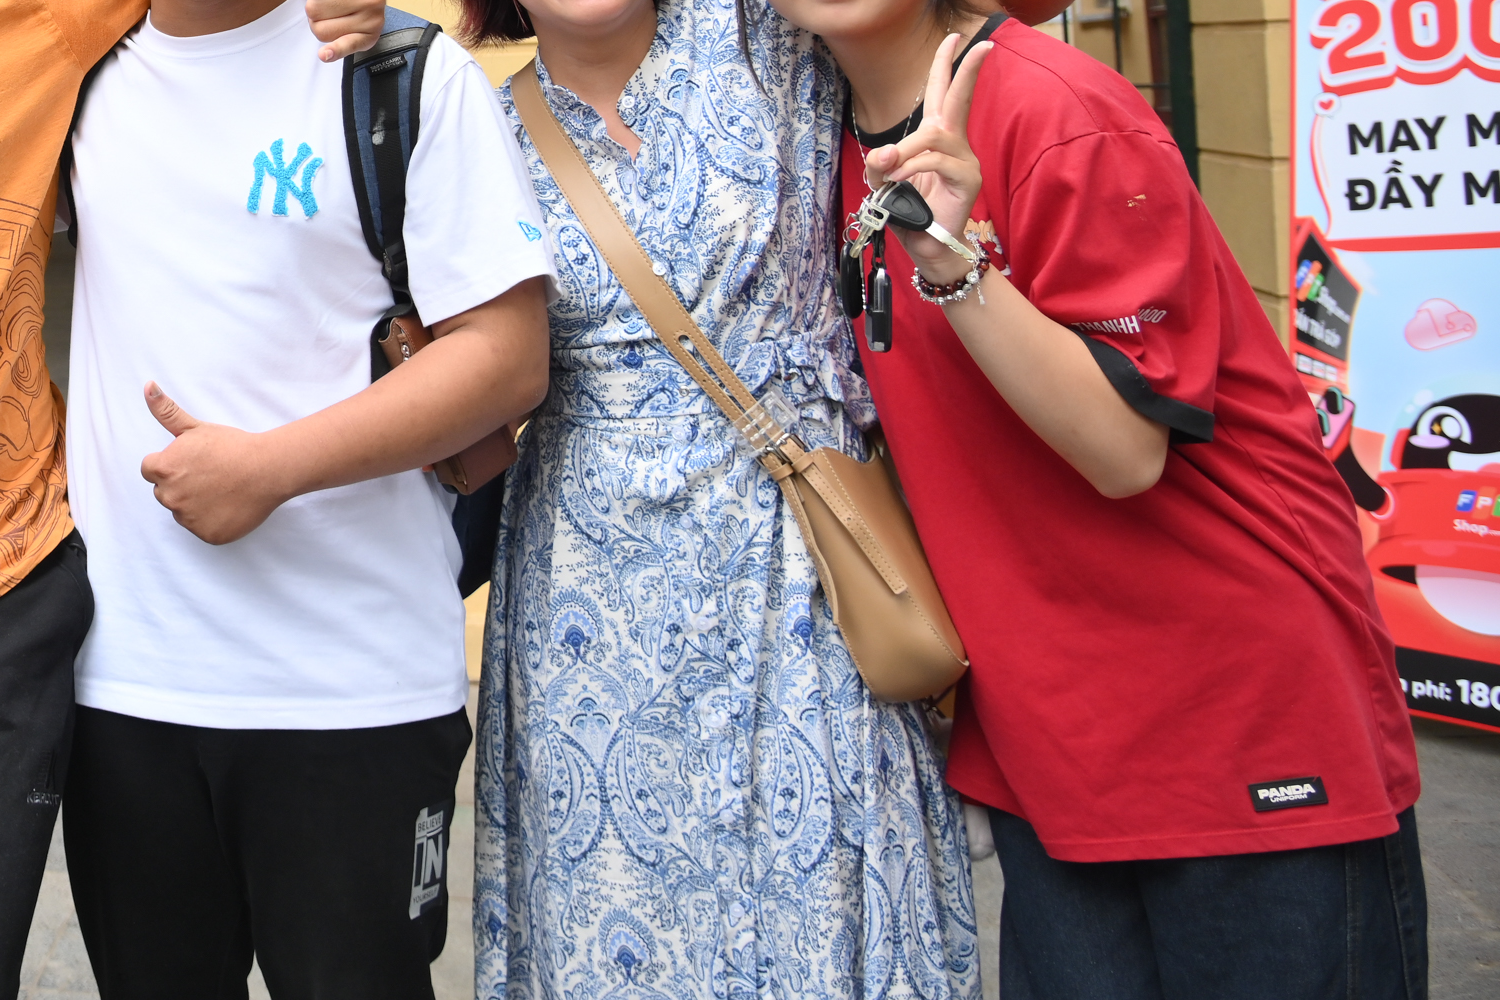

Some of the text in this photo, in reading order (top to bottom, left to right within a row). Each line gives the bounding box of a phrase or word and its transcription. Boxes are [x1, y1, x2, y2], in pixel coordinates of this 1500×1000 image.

[1347, 116, 1447, 156] MAY
[247, 138, 323, 218] NY
[1344, 160, 1445, 211] ĐẦY
[1257, 783, 1316, 799] PANDA
[1270, 794, 1308, 803] UNIFORM
[417, 814, 443, 833] BELIEVE
